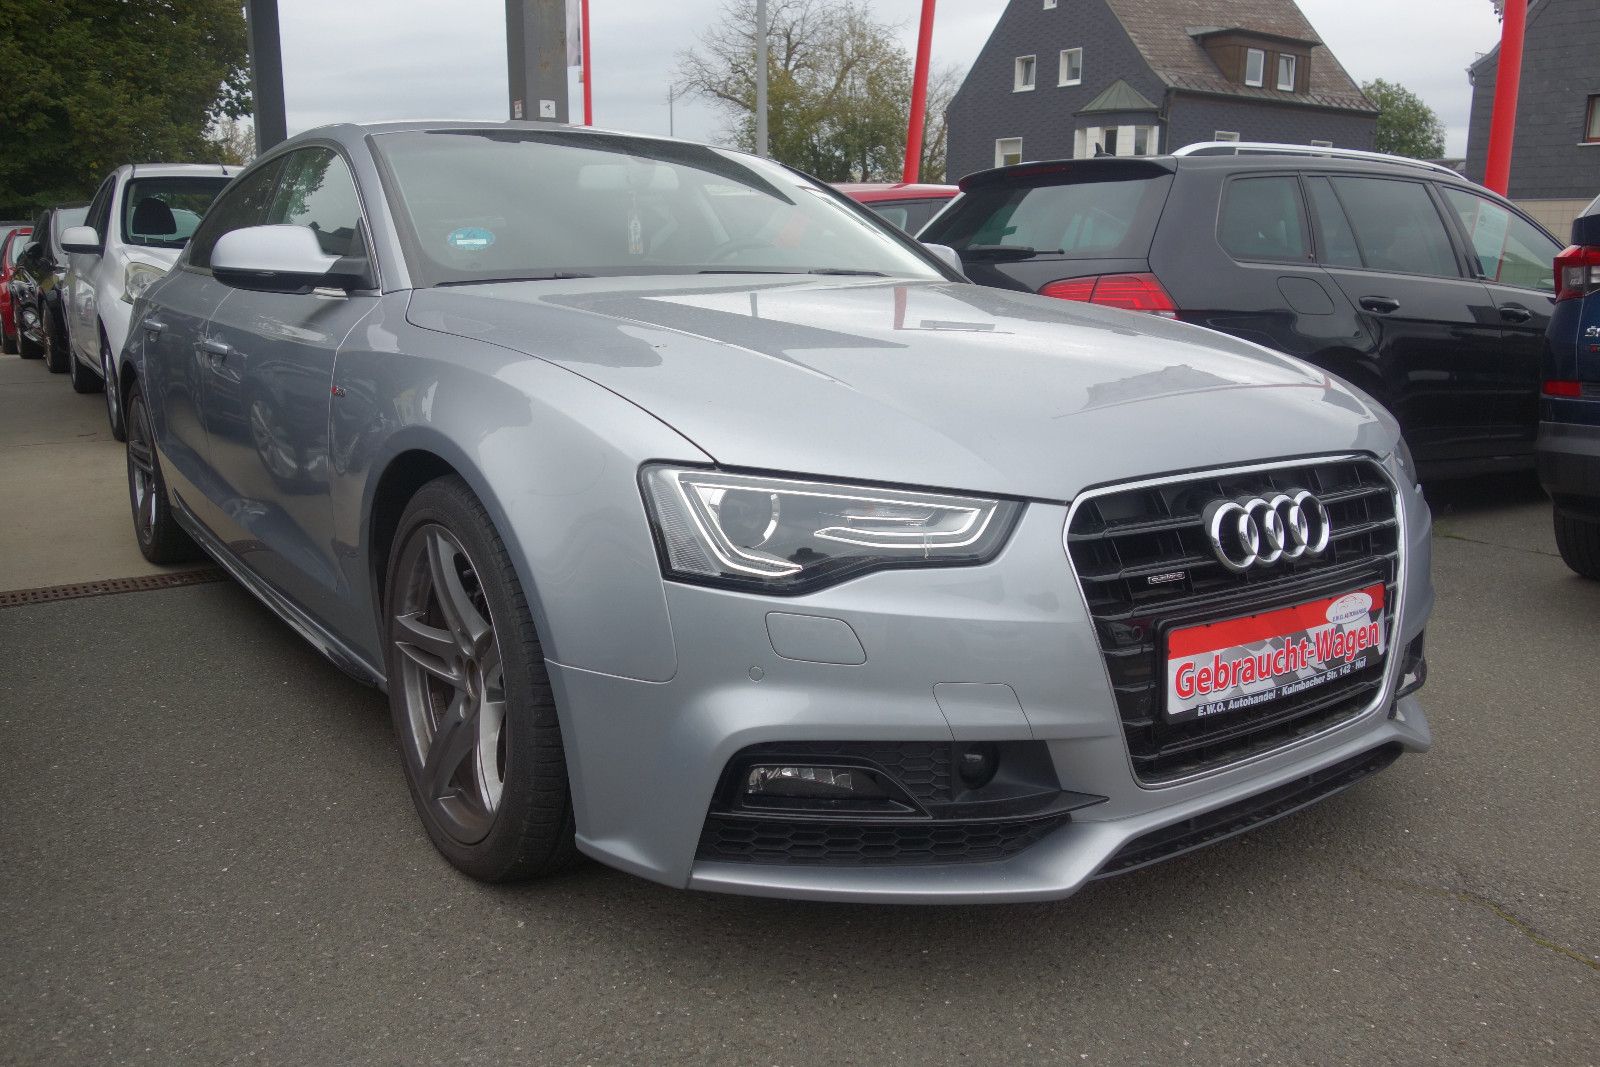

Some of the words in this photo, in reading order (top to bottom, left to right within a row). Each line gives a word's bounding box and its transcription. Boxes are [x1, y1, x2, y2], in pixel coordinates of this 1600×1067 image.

[1175, 621, 1380, 699] Gebraucht-Wagen
[1197, 702, 1225, 717] E.W.O.
[1228, 689, 1275, 710] Autohandel
[1282, 676, 1325, 696] Kulmbacher
[1326, 672, 1338, 684] Str.
[1339, 665, 1351, 678] 142
[1355, 657, 1367, 669] Hof
